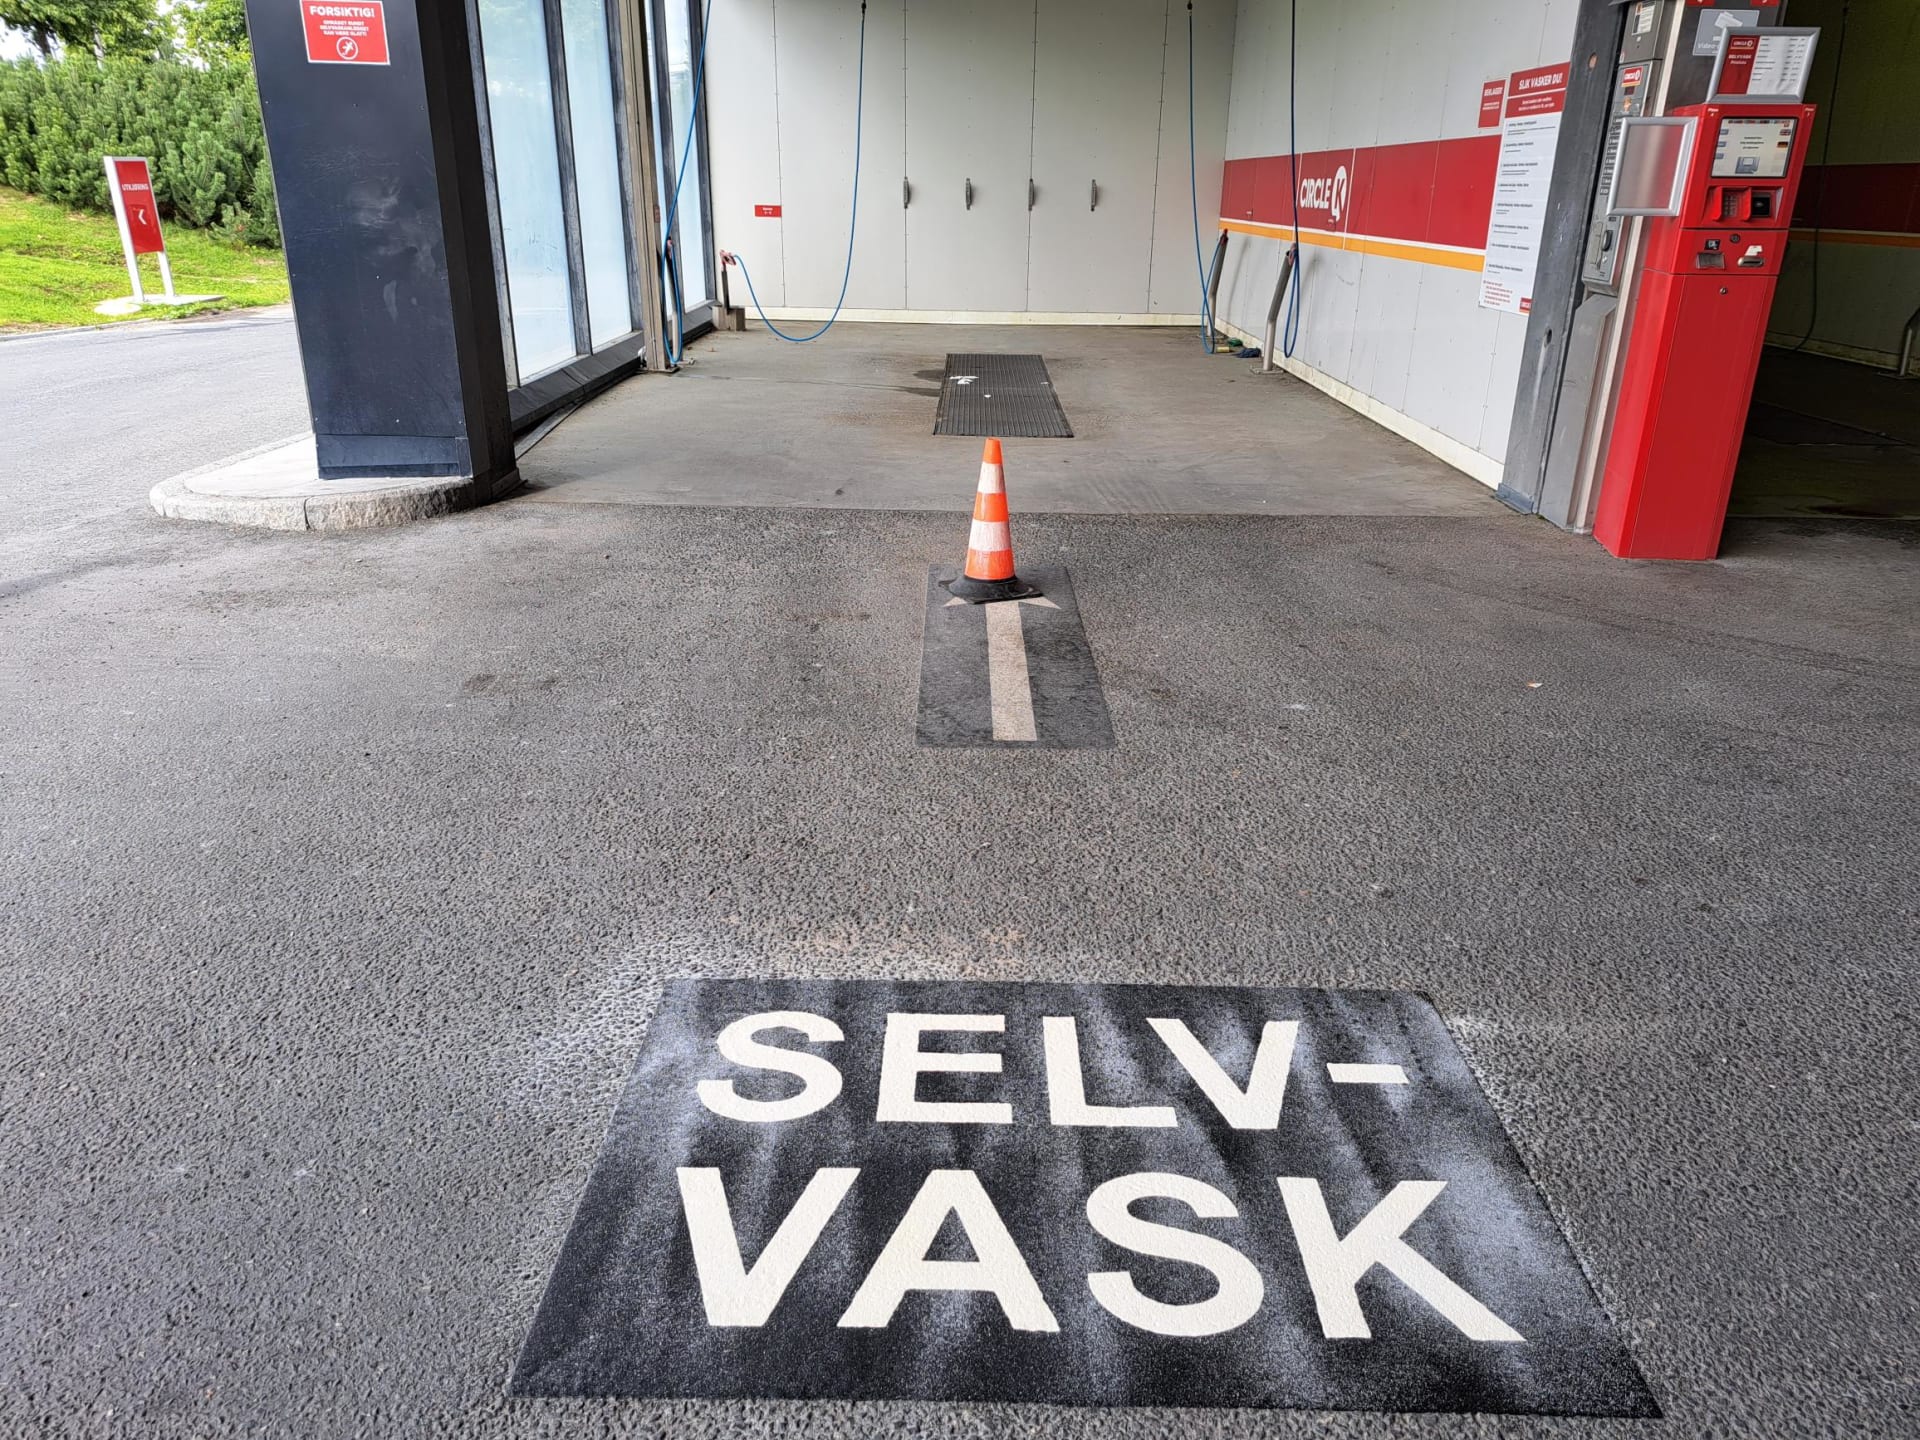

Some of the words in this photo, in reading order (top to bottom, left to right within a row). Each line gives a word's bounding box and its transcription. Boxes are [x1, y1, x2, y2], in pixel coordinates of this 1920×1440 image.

[309, 6, 375, 17] FORSIKTIG!
[1530, 75, 1552, 88] VASKER
[1300, 178, 1332, 209] CIRCLE
[1331, 168, 1347, 220] K
[696, 1010, 1410, 1130] SELV-
[676, 1166, 1527, 1342] VASK
